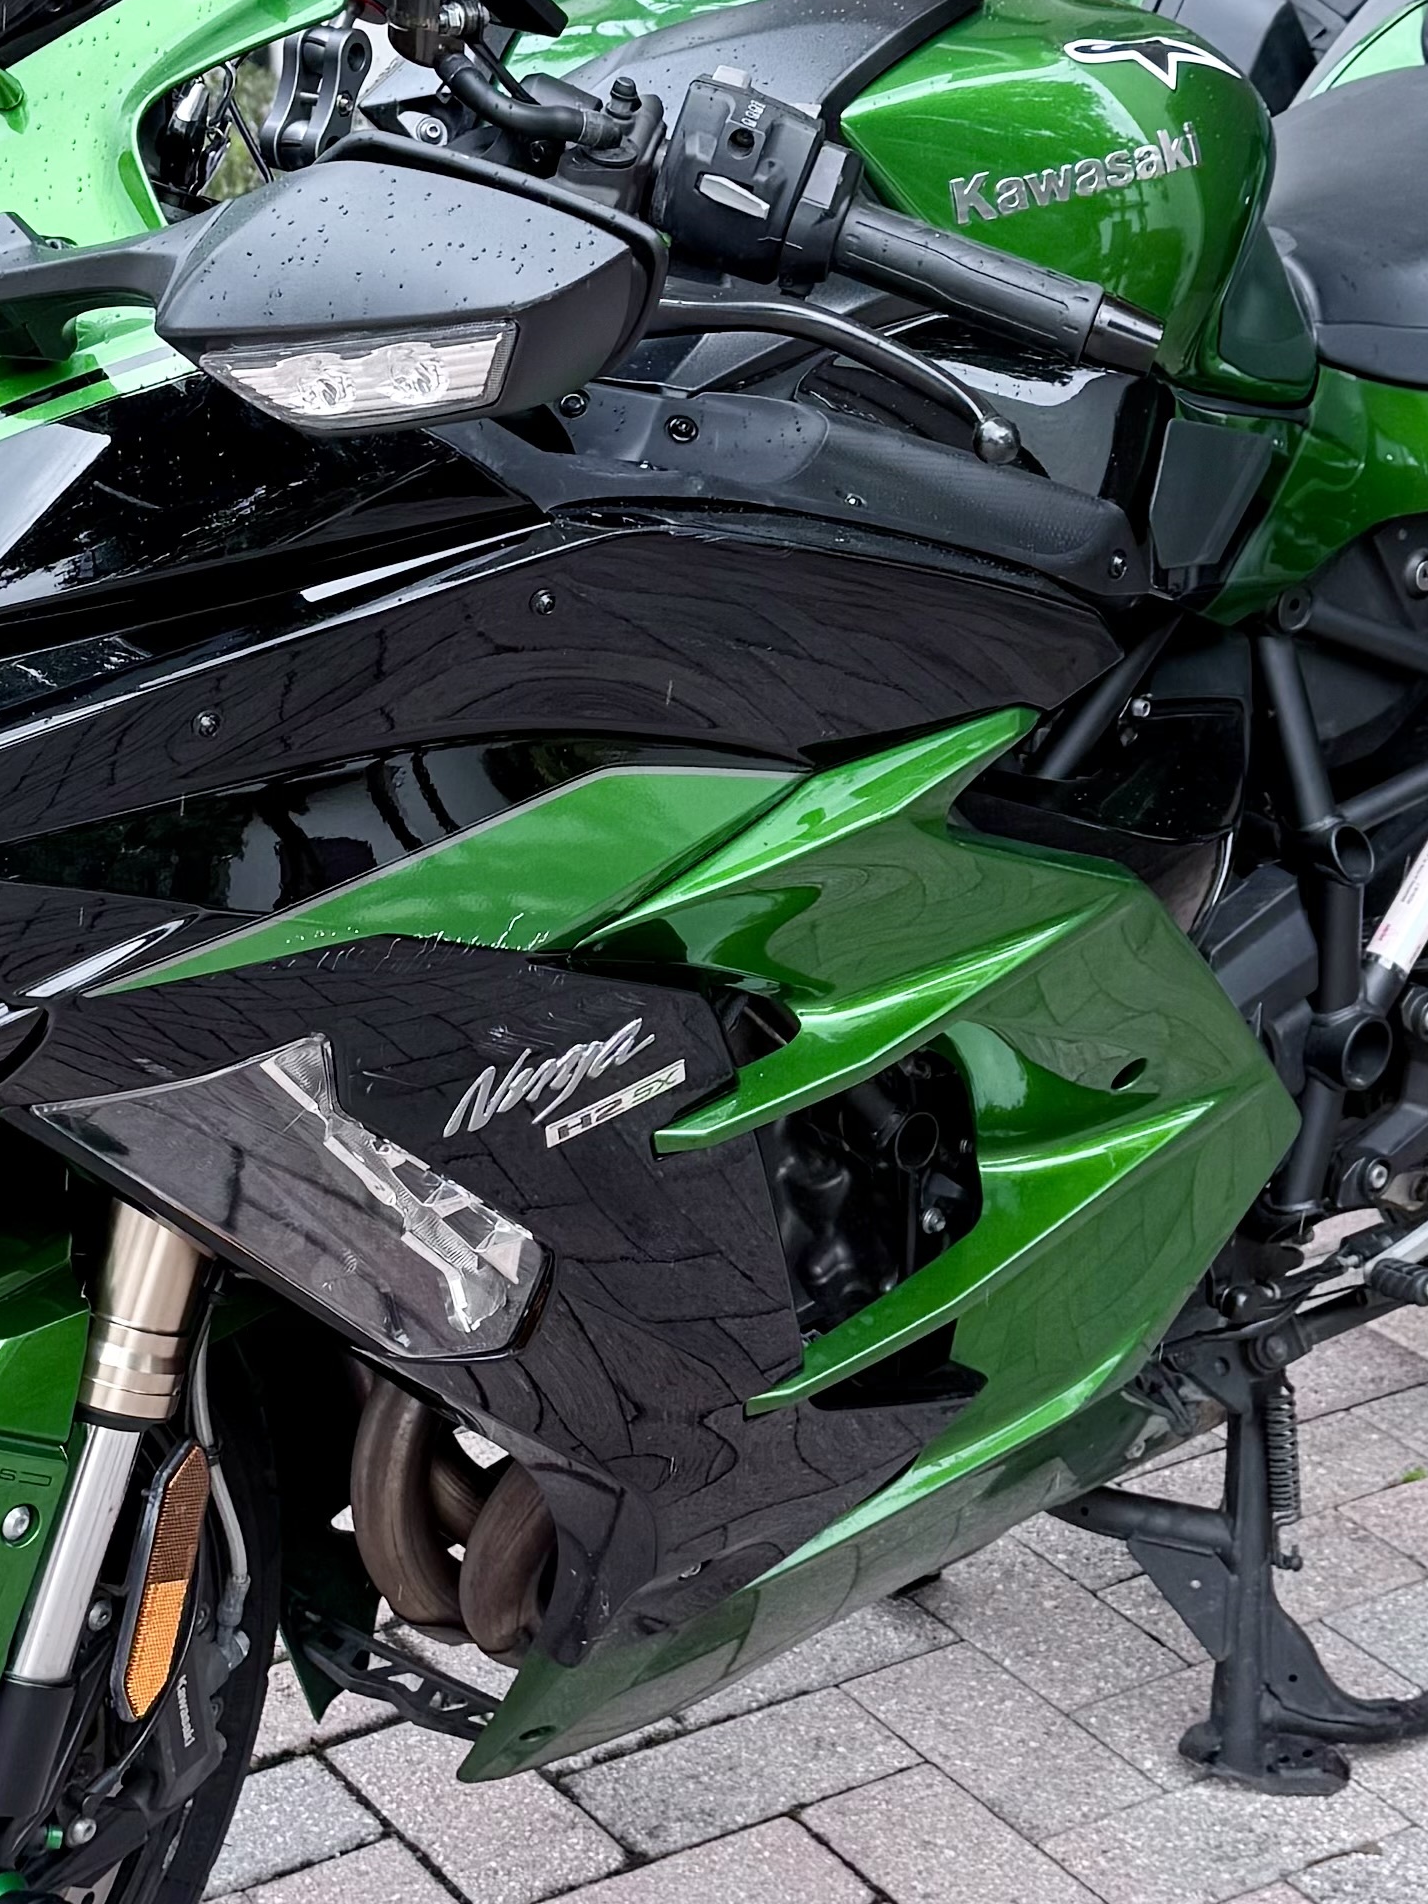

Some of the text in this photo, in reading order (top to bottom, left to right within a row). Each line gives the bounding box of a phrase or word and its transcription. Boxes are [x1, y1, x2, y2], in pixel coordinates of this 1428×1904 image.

[949, 121, 1202, 224] Kawasaki
[443, 1017, 655, 1137] Ninja
[558, 1068, 680, 1140] H2 SX
[176, 1674, 196, 1748] Kawasaki
